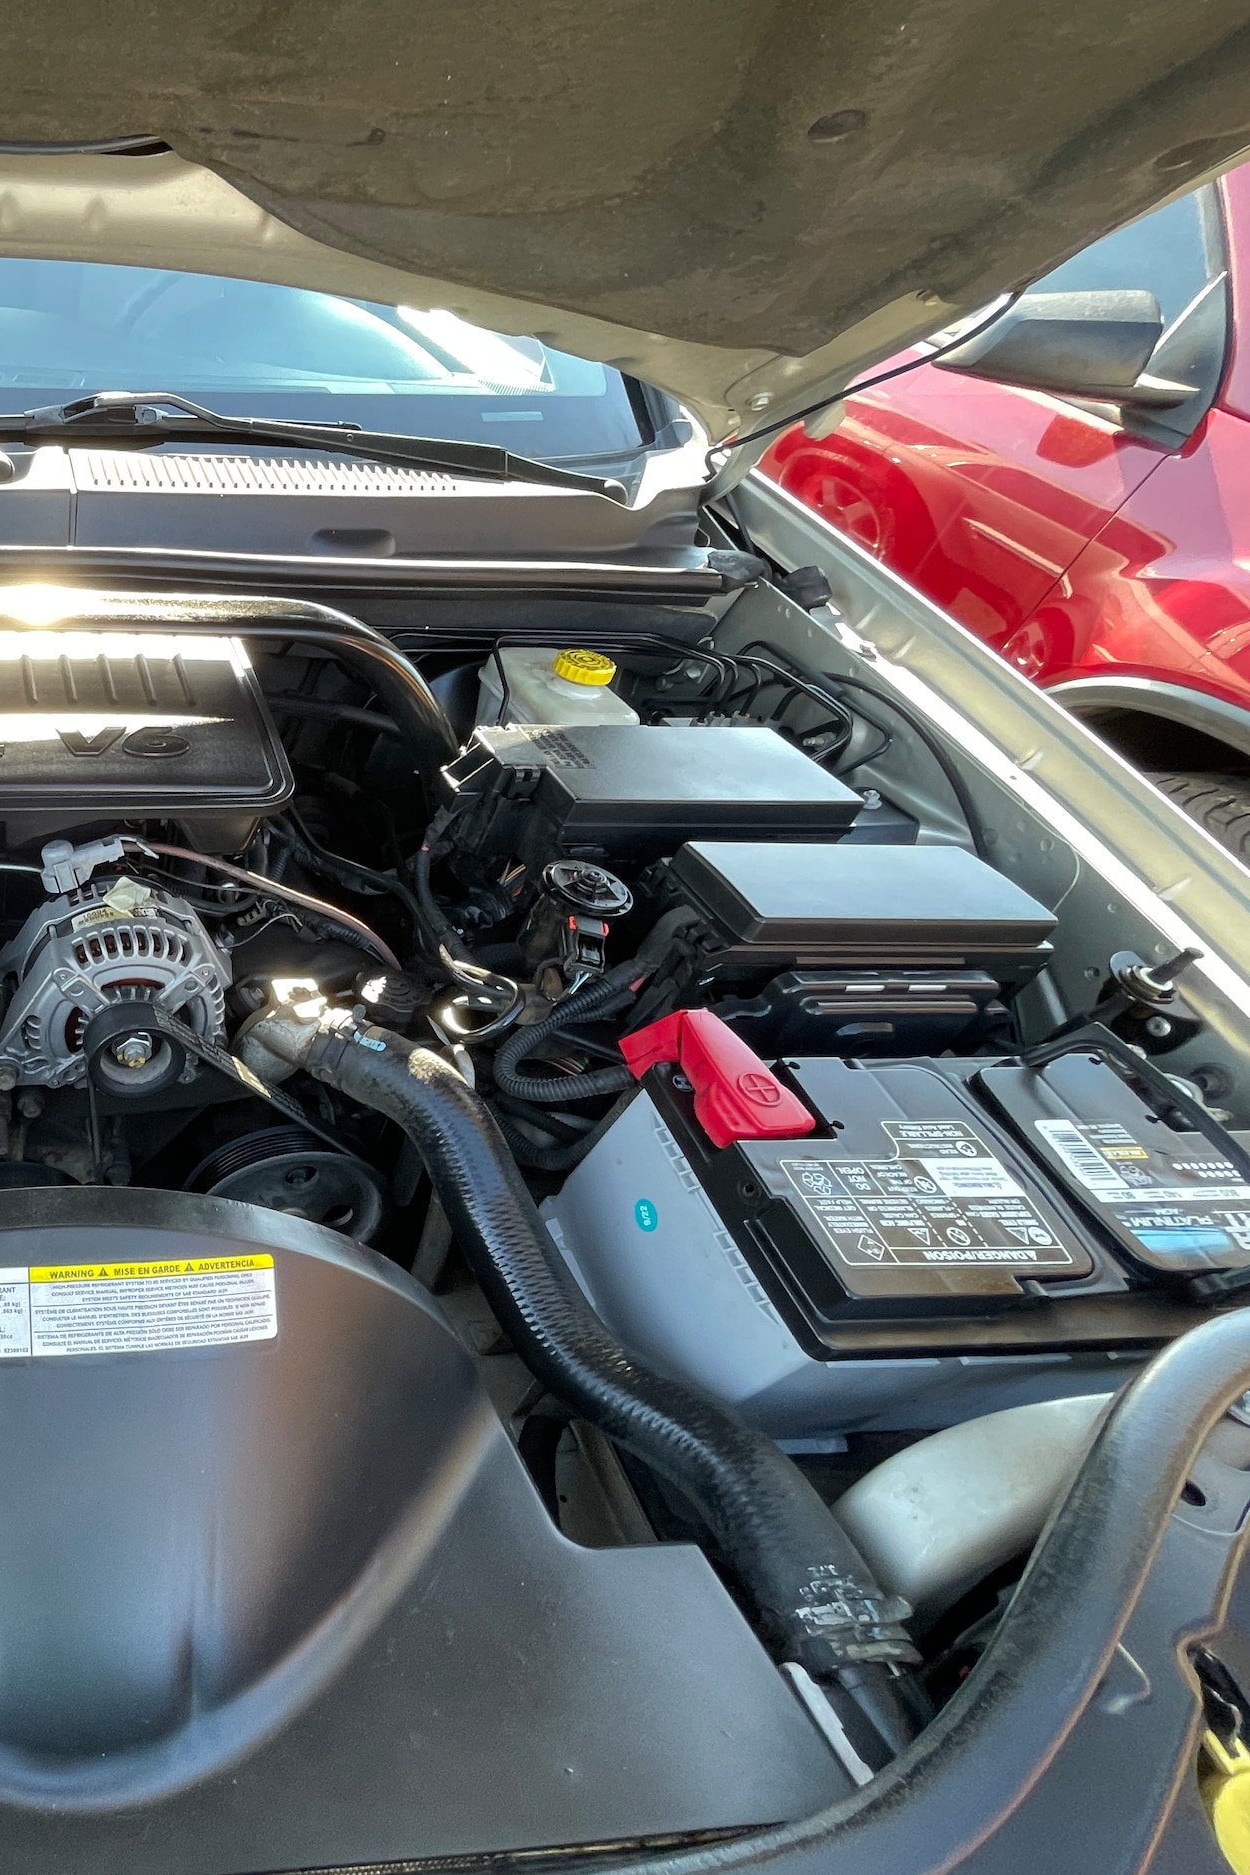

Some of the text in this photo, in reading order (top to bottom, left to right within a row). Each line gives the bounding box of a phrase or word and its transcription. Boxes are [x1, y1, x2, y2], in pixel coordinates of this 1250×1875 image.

[55, 726, 191, 758] V6
[847, 1175, 868, 1183] NOT
[856, 1183, 871, 1191] DO
[1130, 1216, 1215, 1227] PLATINUM
[922, 1251, 1031, 1261] DANGER/POISON
[49, 1259, 254, 1280] WARNING MISE EN GARDE ADVERTENCIA
